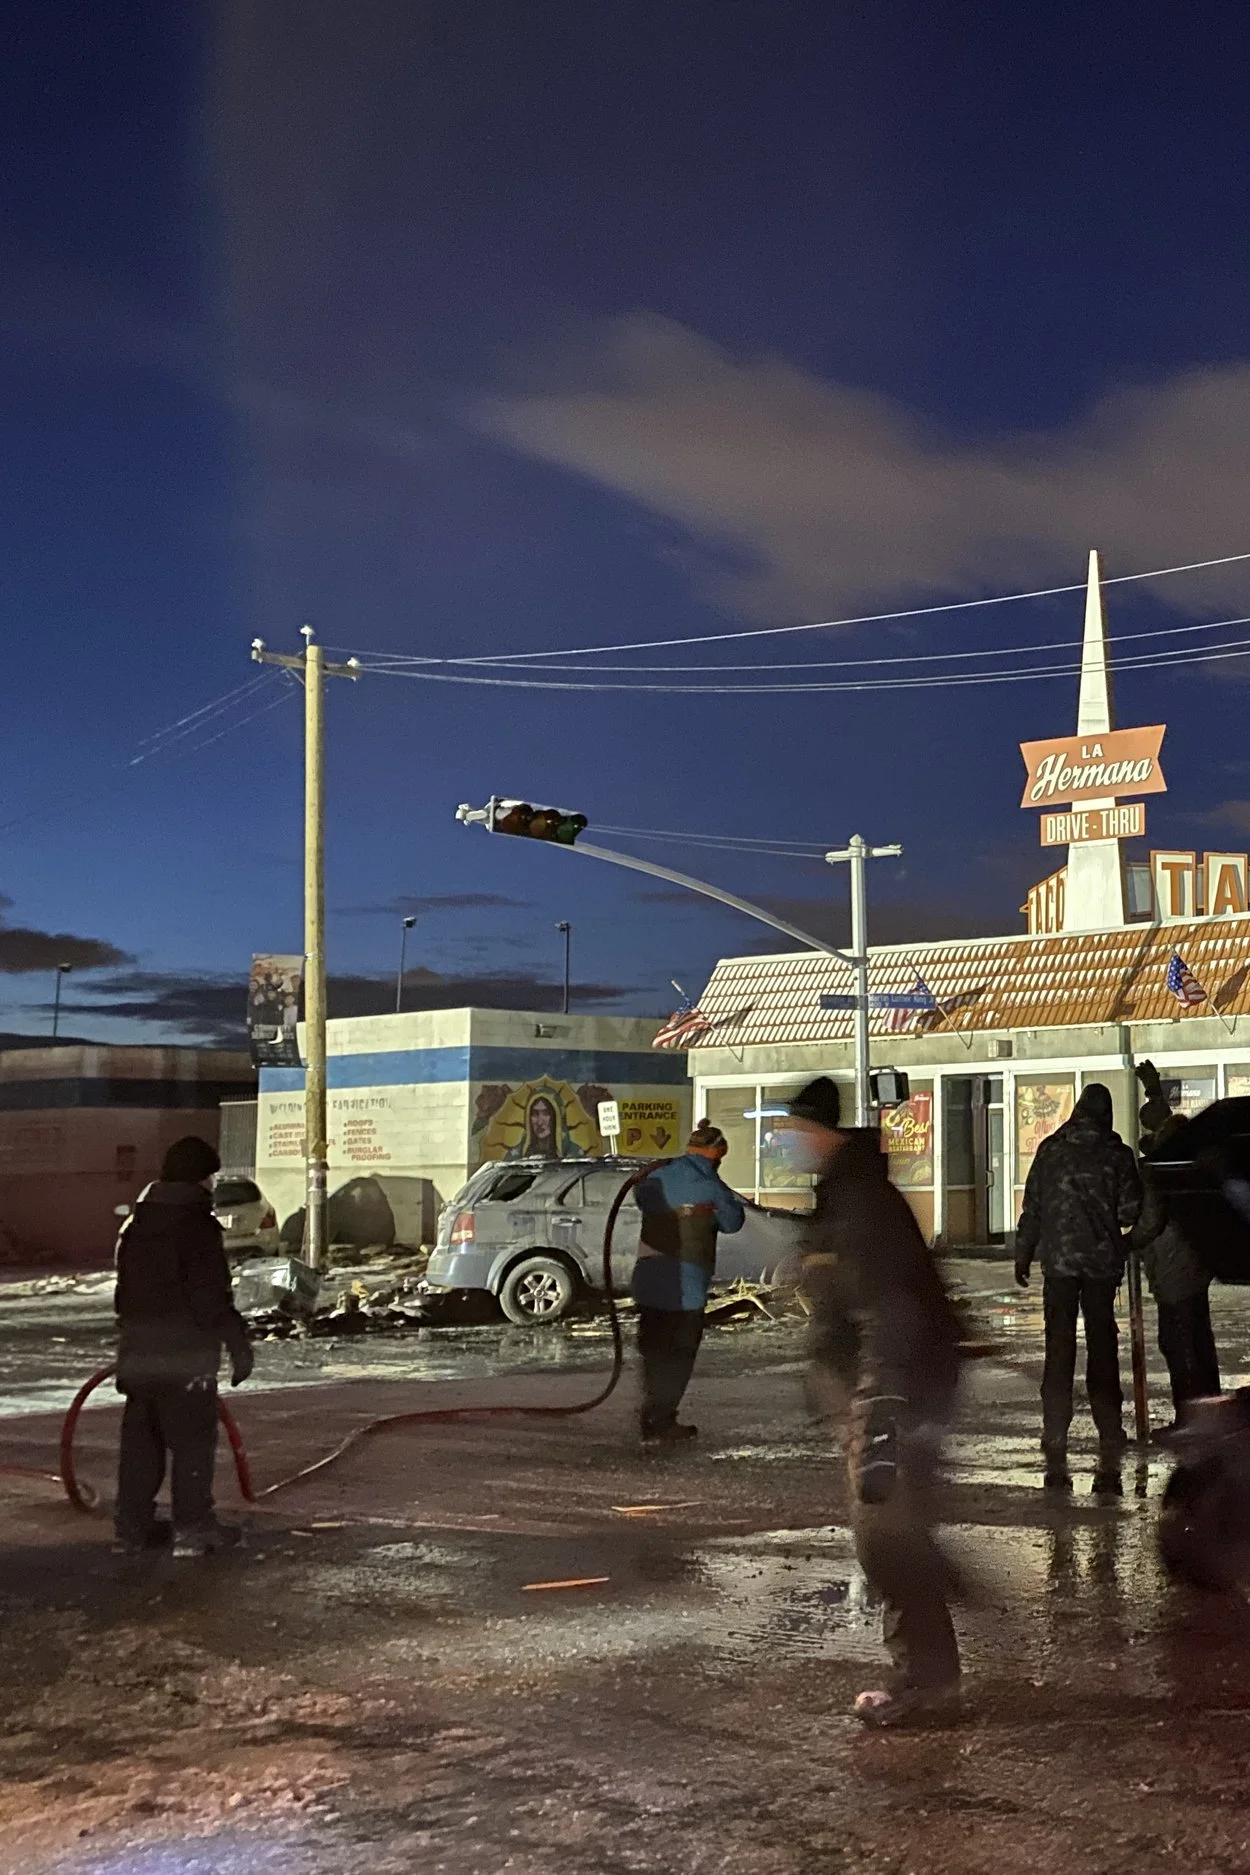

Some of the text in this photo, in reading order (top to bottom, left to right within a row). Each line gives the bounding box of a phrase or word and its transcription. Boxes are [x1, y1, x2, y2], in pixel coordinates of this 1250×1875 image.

[1082, 743, 1103, 759] LA
[1030, 752, 1153, 801] Hermana
[1028, 876, 1065, 934] TACO
[868, 994, 889, 1002] Martin
[891, 994, 911, 1002] Luther
[913, 995, 926, 1004] King
[622, 1102, 673, 1111] PARKING
[620, 1111, 677, 1120] ENTRANCE
[346, 1119, 373, 1127] ROOFS
[346, 1128, 377, 1136] FENCES
[901, 1119, 930, 1138] Best
[272, 1131, 293, 1139] CAST
[346, 1137, 372, 1145] GATES
[888, 1137, 925, 1146] MEXICAN
[346, 1146, 383, 1154] BURGLAR
[351, 1153, 392, 1161] PROOFING
